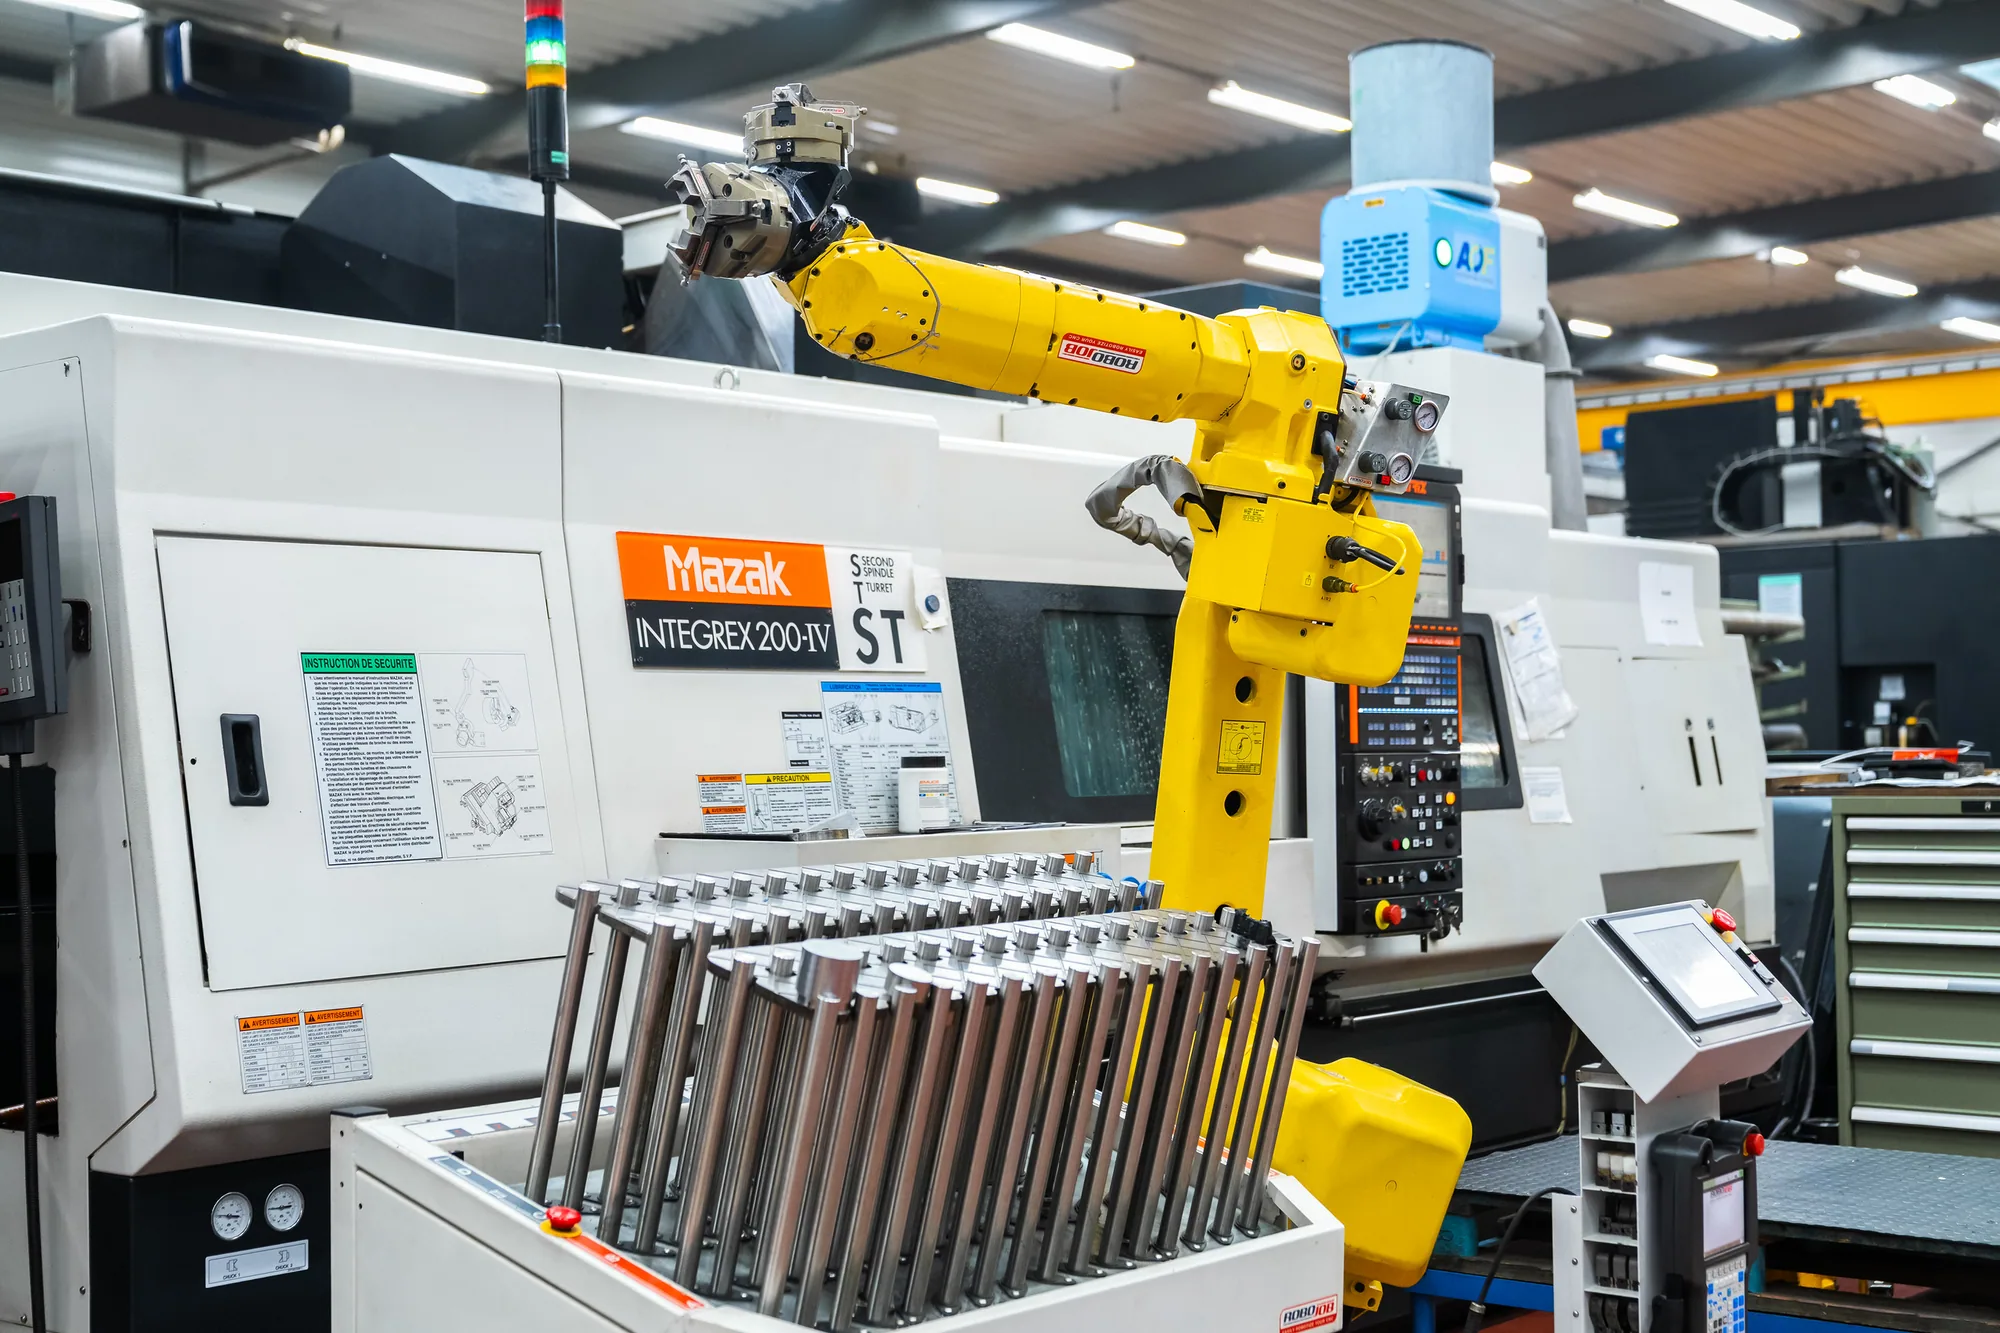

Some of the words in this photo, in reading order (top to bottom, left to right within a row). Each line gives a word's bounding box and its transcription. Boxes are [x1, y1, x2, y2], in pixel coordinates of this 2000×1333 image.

[1098, 341, 1124, 350] ROBOTIZE
[1064, 344, 1138, 370] ROBOJOB
[851, 554, 861, 577] S
[862, 556, 894, 567] SECOND
[663, 544, 792, 596] Mazak
[864, 568, 894, 579] SPINDLE
[853, 581, 864, 604] T
[866, 582, 893, 594] TURRET
[636, 617, 755, 650] INTEGREX
[756, 622, 831, 652] 200-IV
[853, 608, 905, 664] ST
[305, 658, 360, 668] INSTRUCTION
[362, 658, 373, 668] DE
[375, 659, 413, 668] SECURITE
[252, 1016, 296, 1026] AVERTISSEMENT
[317, 1010, 360, 1020] AVERTISSEMENT
[1284, 1302, 1334, 1322] ROBOJOB
